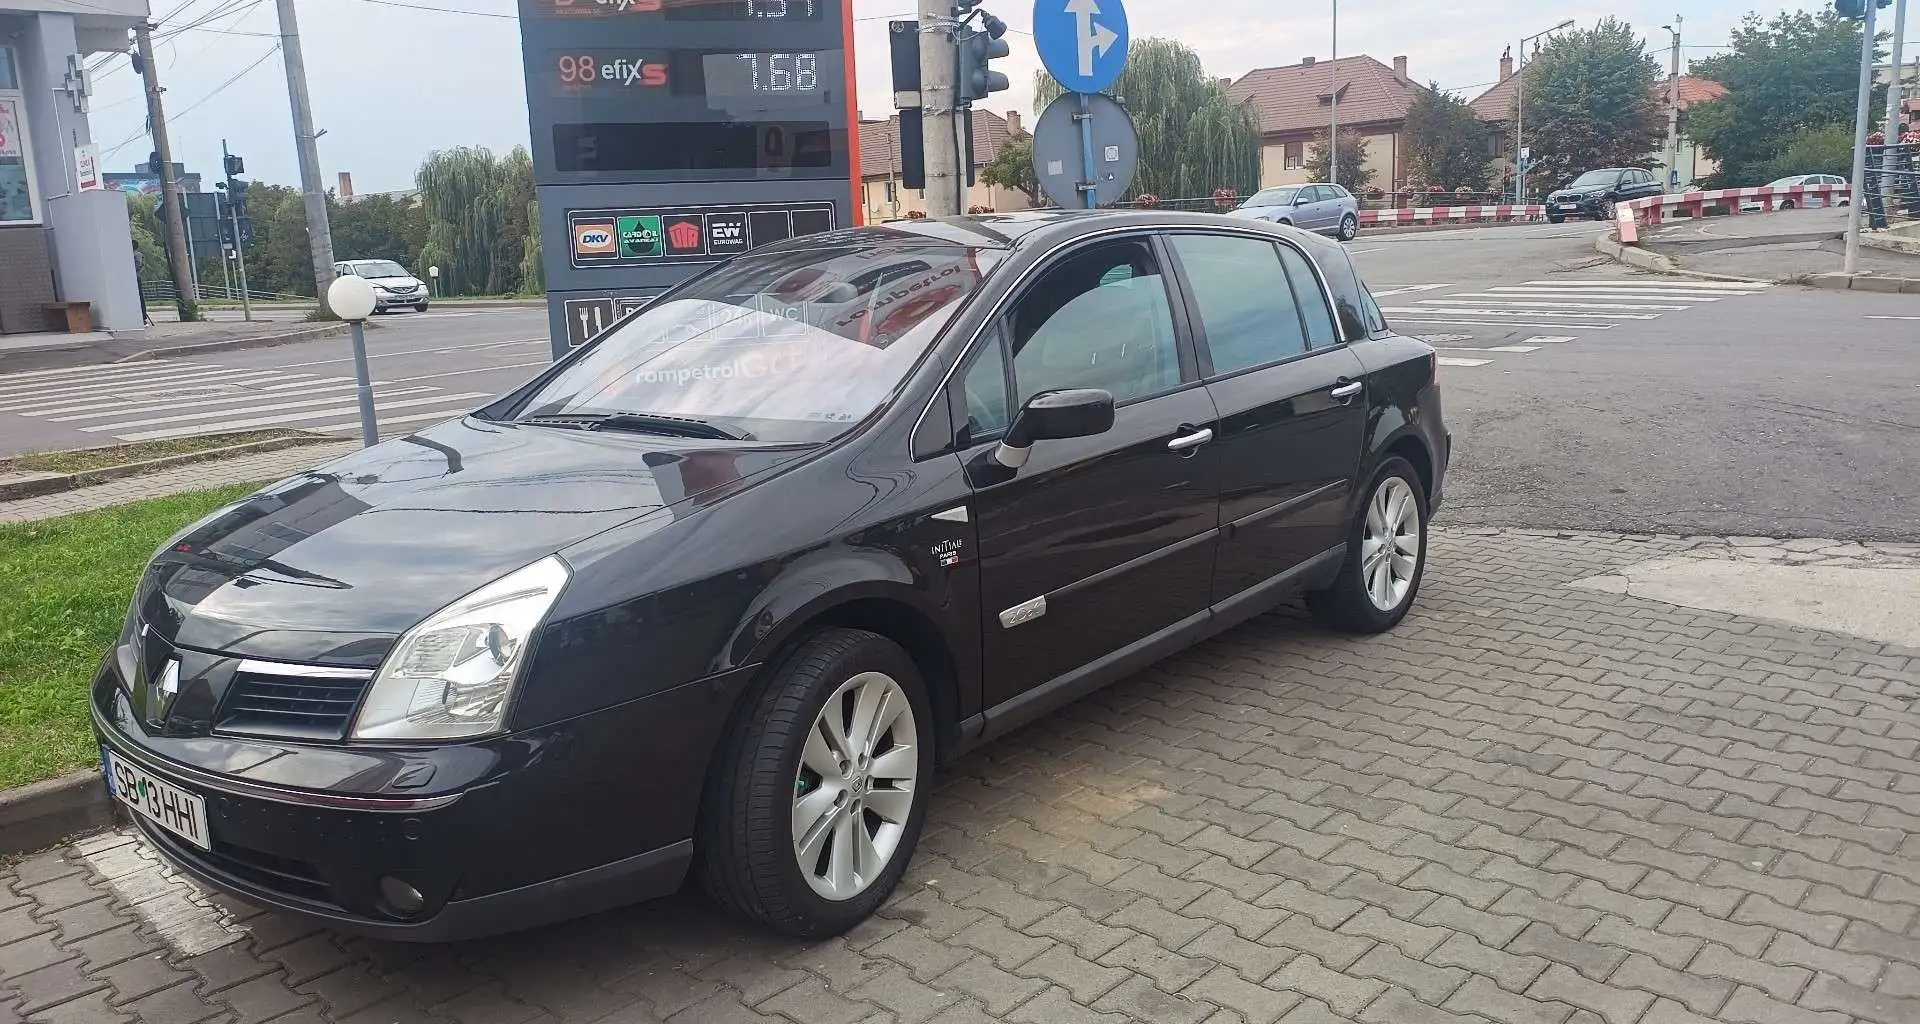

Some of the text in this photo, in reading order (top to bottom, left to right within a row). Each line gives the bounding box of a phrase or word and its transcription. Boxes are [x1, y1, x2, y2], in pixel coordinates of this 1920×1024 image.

[559, 55, 596, 82] 98
[736, 53, 817, 91] 7.68
[582, 234, 609, 244] DKV
[770, 307, 799, 321] WC
[635, 359, 741, 387] rompetrol
[931, 539, 963, 555] INITIALE
[115, 761, 139, 805] SB
[142, 776, 160, 819] 13
